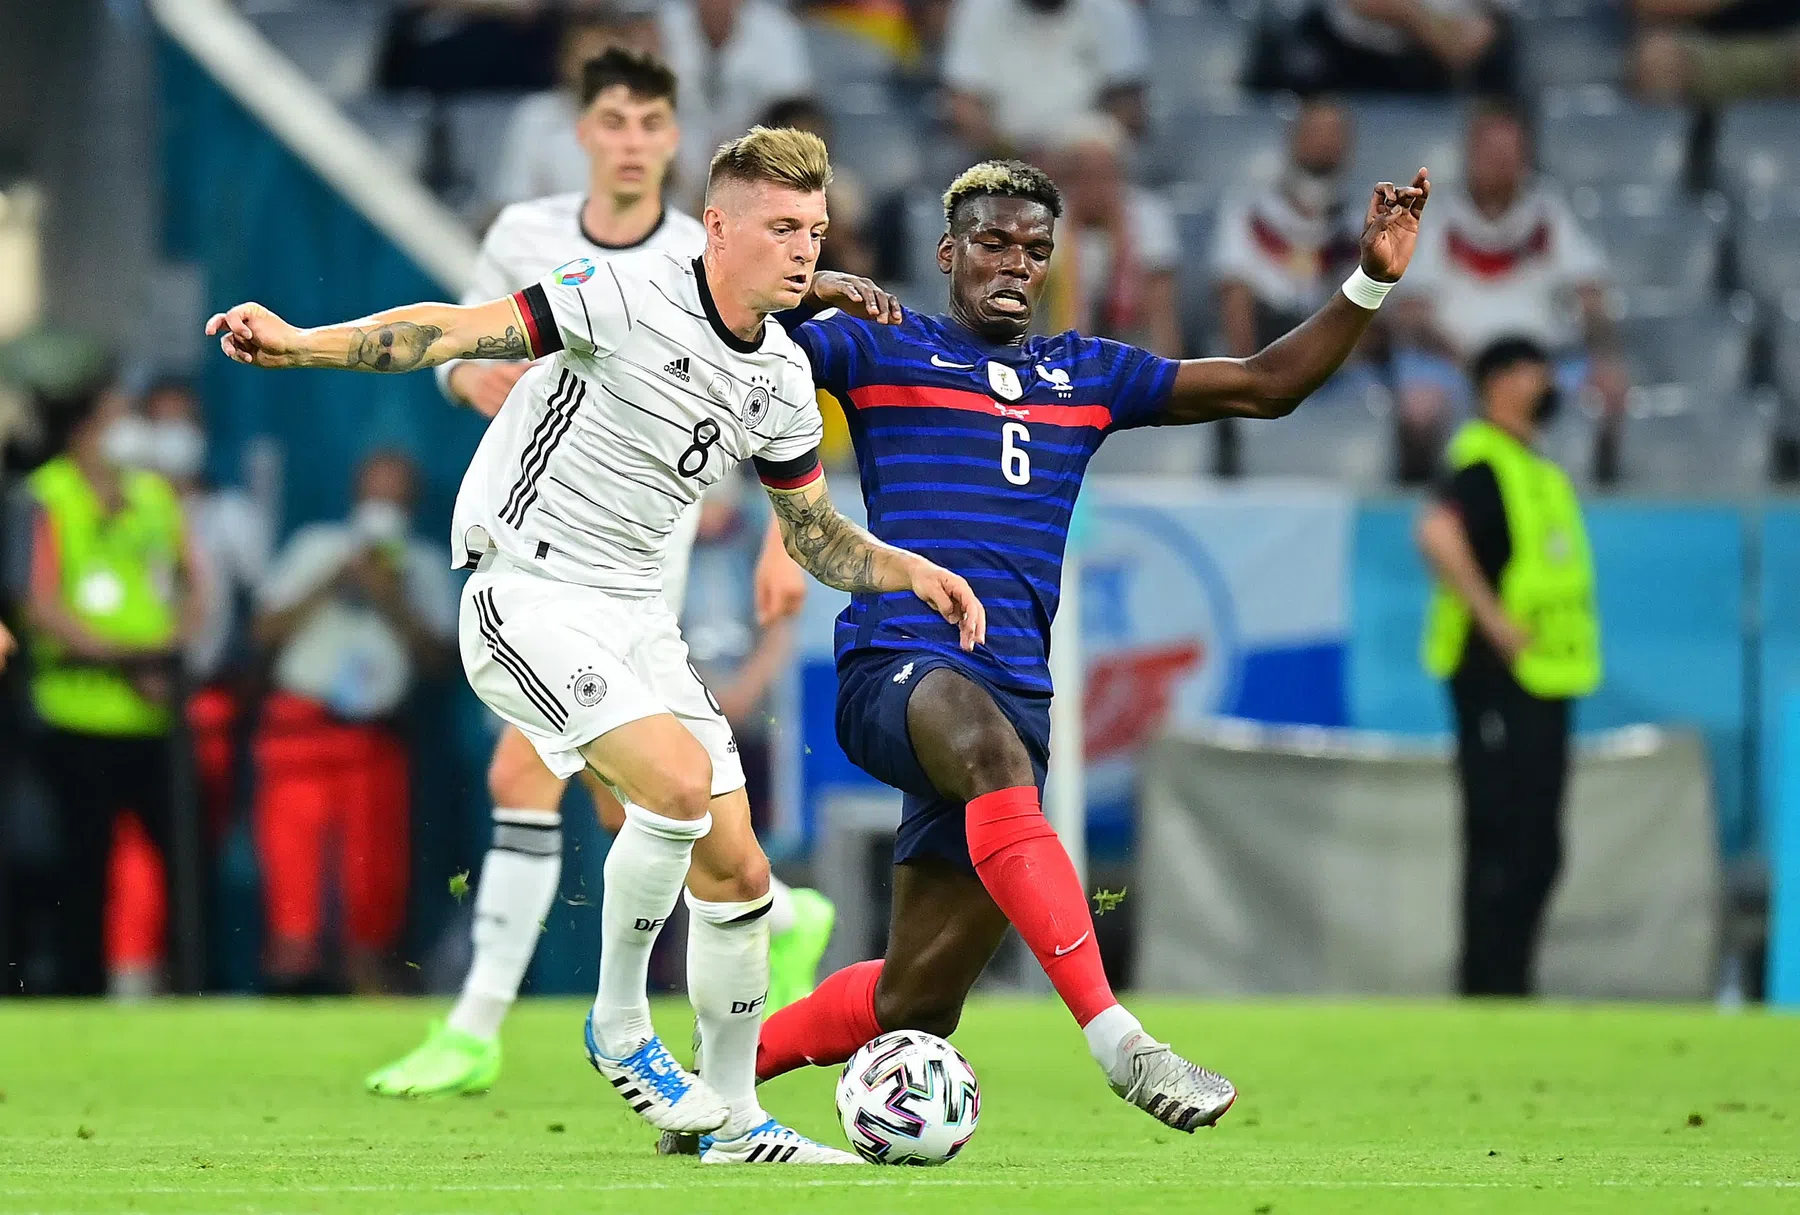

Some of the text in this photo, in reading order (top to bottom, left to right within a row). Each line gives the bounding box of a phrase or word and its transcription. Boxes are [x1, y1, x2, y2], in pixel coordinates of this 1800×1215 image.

[663, 364, 691, 382] adidas
[678, 417, 721, 478] 8
[1001, 422, 1031, 485] 6
[731, 990, 768, 1014] DF
